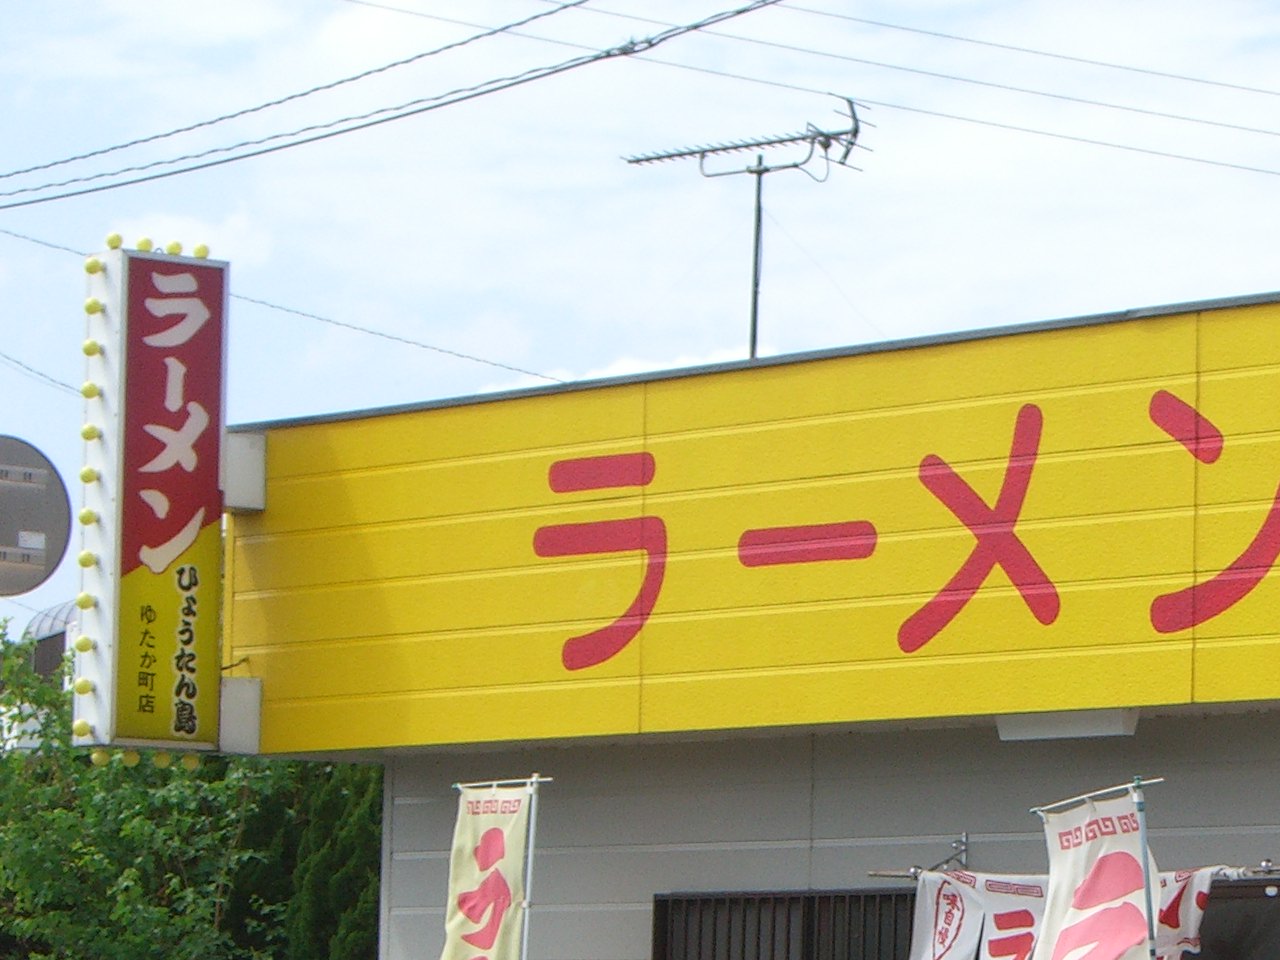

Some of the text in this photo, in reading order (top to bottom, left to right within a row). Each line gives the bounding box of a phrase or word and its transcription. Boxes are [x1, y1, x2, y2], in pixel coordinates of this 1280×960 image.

[139, 270, 212, 575] ラーメン
[138, 604, 157, 714] ゆたか町店
[173, 565, 199, 736] ひょうたん島
